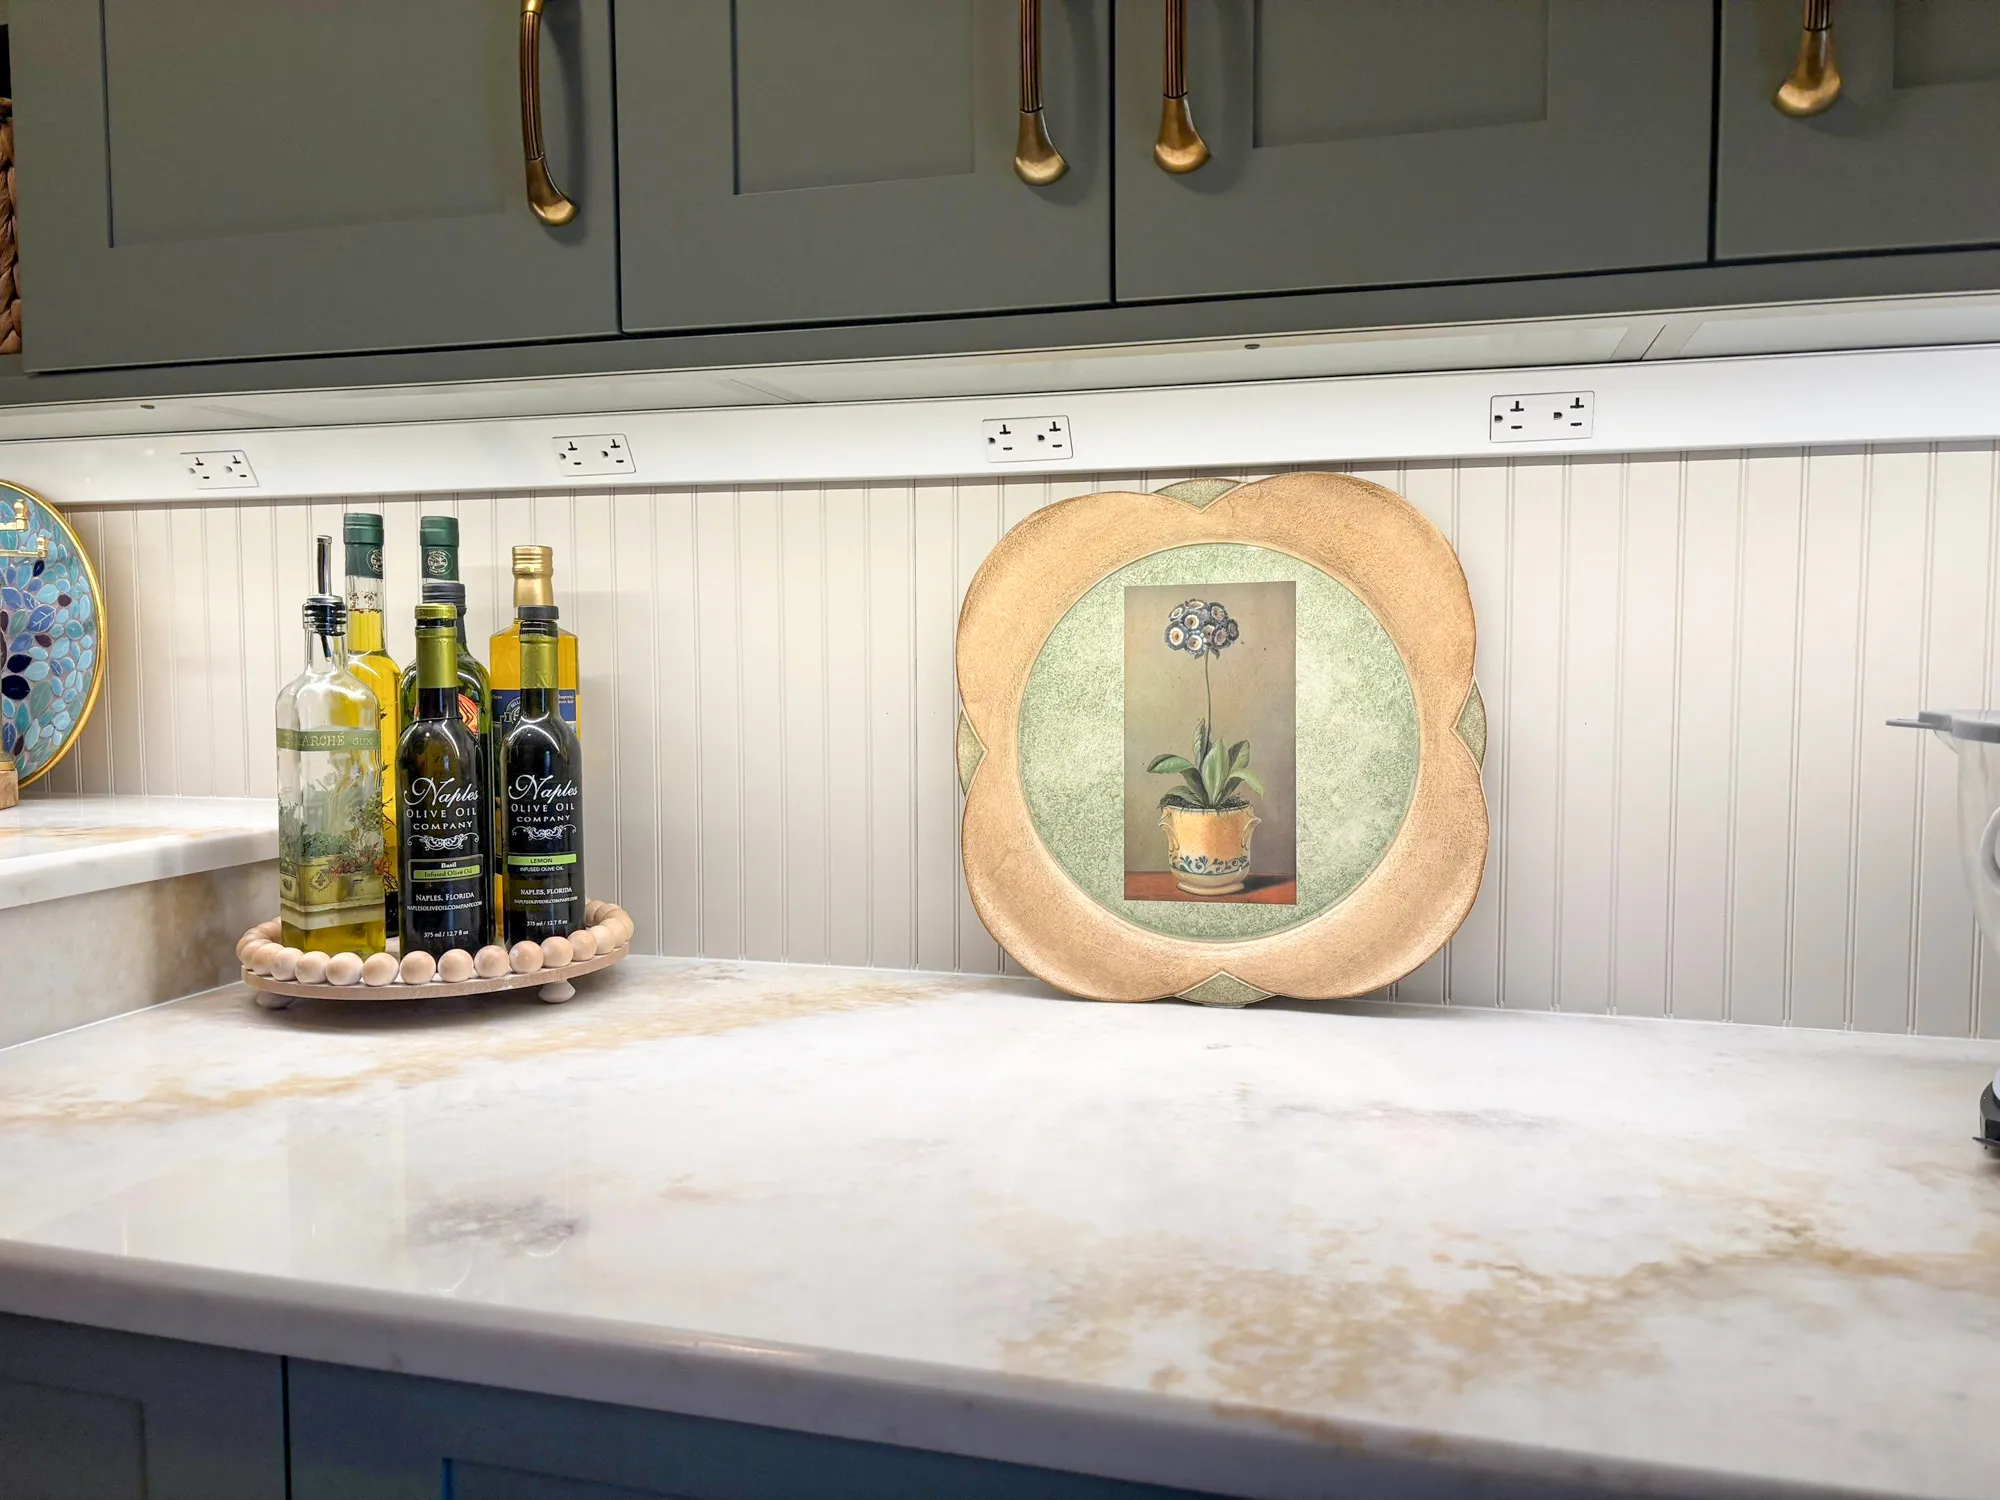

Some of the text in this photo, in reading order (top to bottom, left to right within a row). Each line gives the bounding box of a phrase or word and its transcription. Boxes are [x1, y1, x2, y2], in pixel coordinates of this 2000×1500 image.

[404, 777, 479, 808] Naples
[508, 774, 578, 804] Naples
[406, 807, 477, 818] OLIVE OIL
[510, 802, 574, 812] OLIVE OIL
[413, 820, 473, 831] COMPANY
[446, 892, 474, 900] FLORIDA
